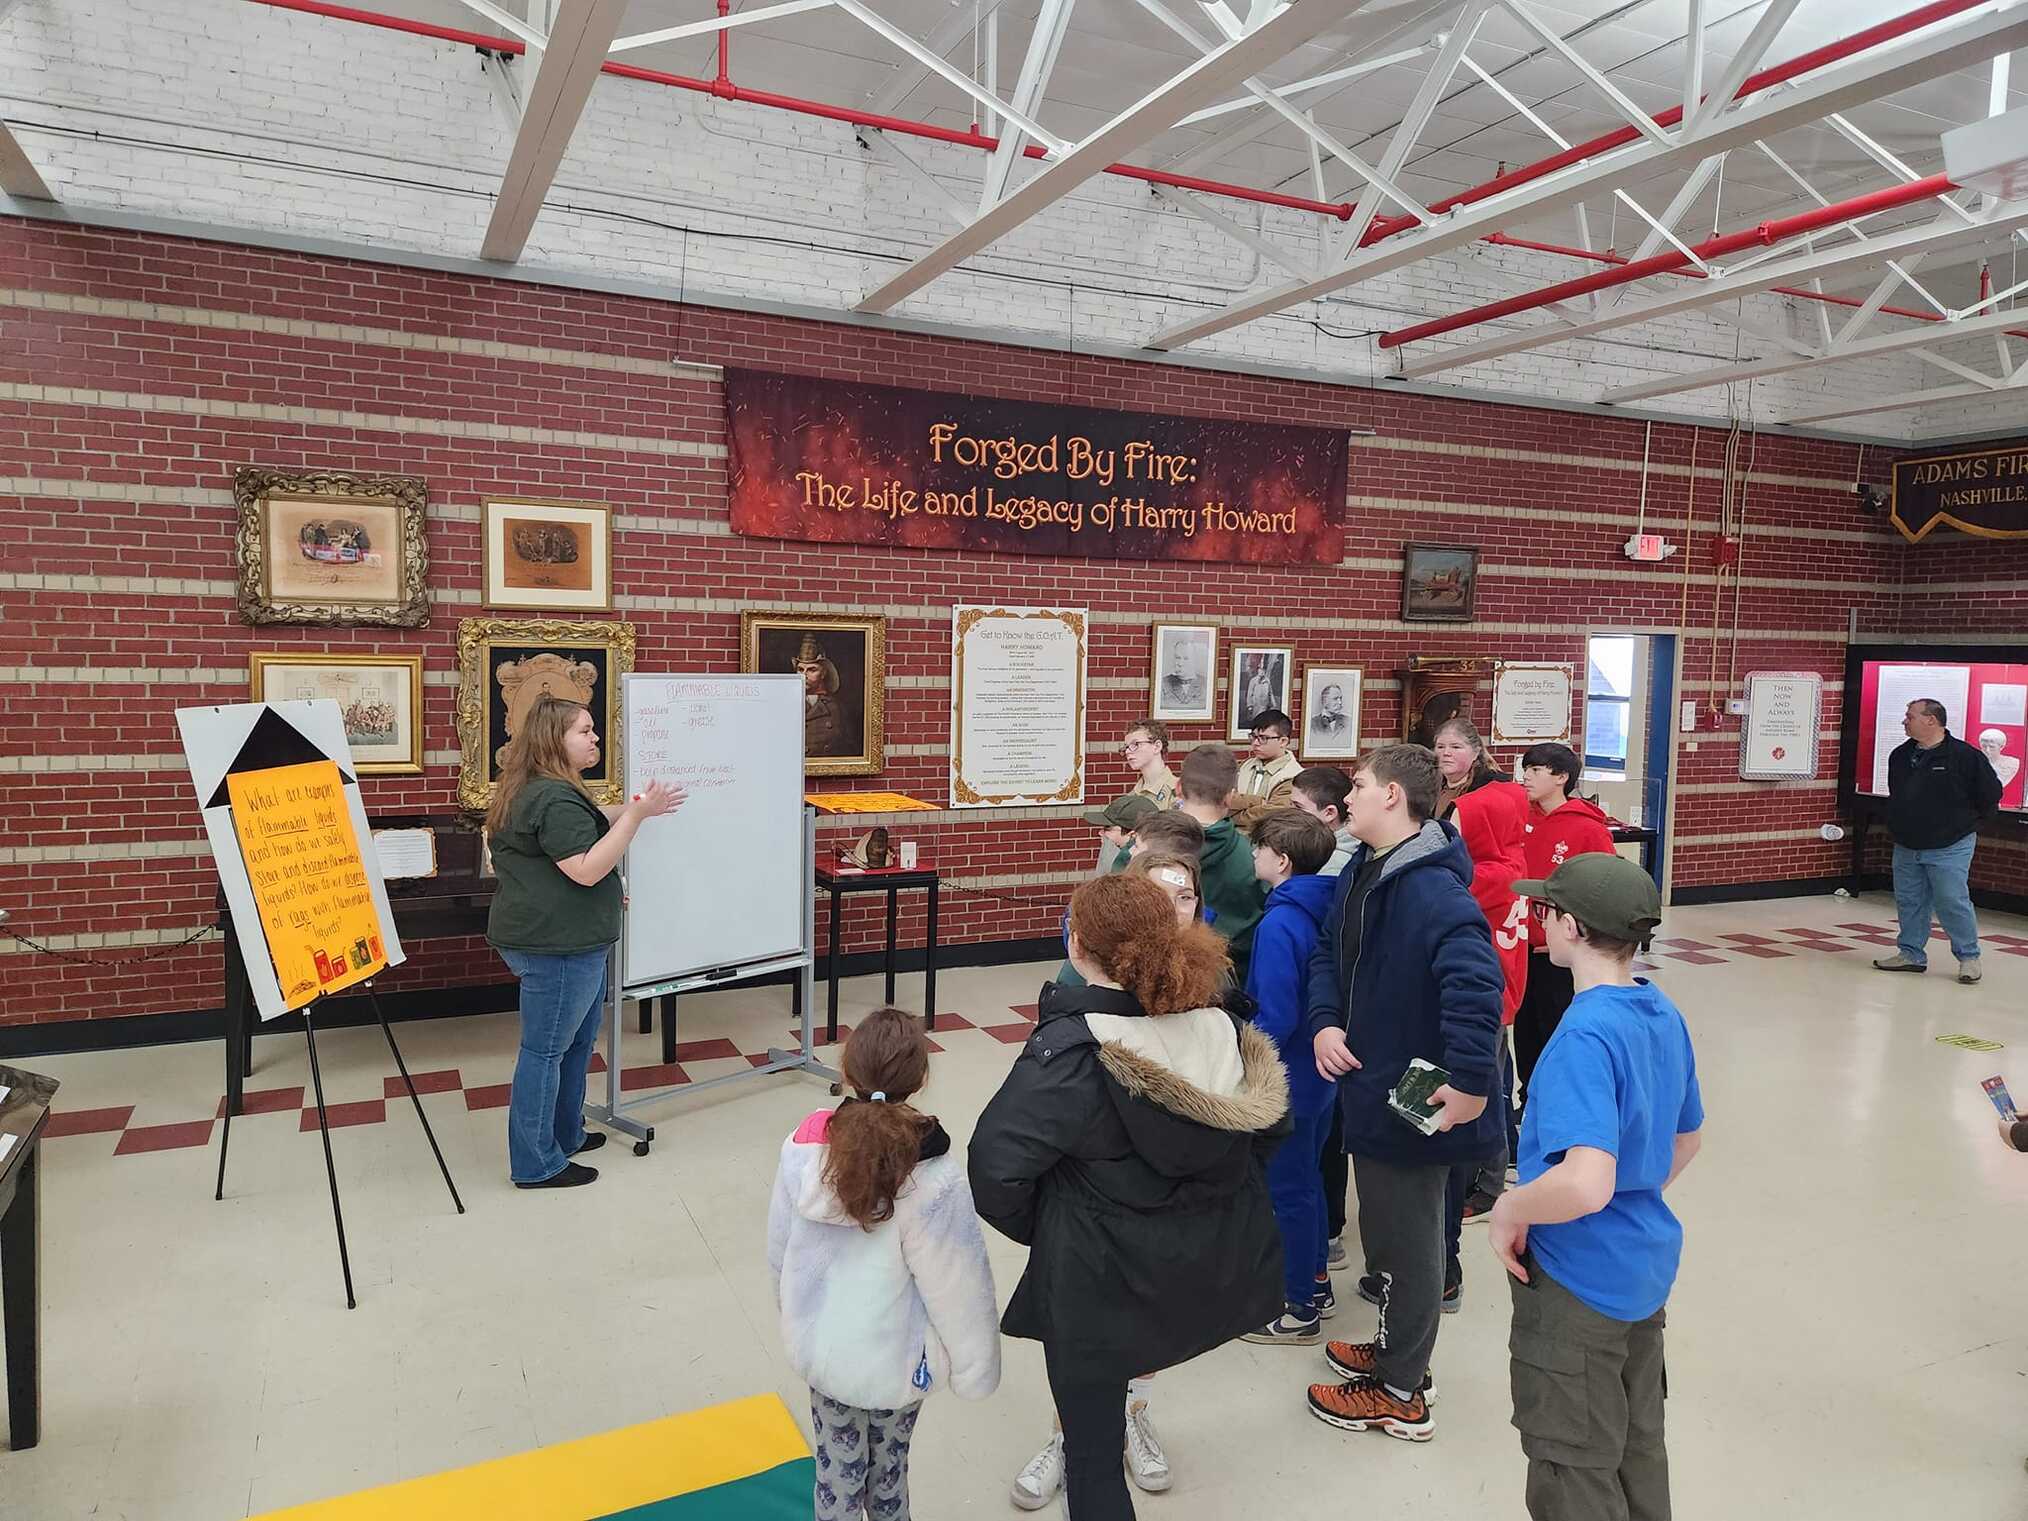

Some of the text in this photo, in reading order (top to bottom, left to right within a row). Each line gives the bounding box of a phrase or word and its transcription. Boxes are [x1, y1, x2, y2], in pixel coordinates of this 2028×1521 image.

[929, 423, 1198, 486] Forged By Fire:
[1912, 458, 1988, 485] ADAMS
[795, 472, 1297, 537] The Life and Legacy of Harry Howard
[243, 785, 280, 813] What
[286, 787, 302, 803] are
[249, 840, 271, 864] and
[1551, 854, 1568, 864] 53
[272, 911, 284, 930] of
